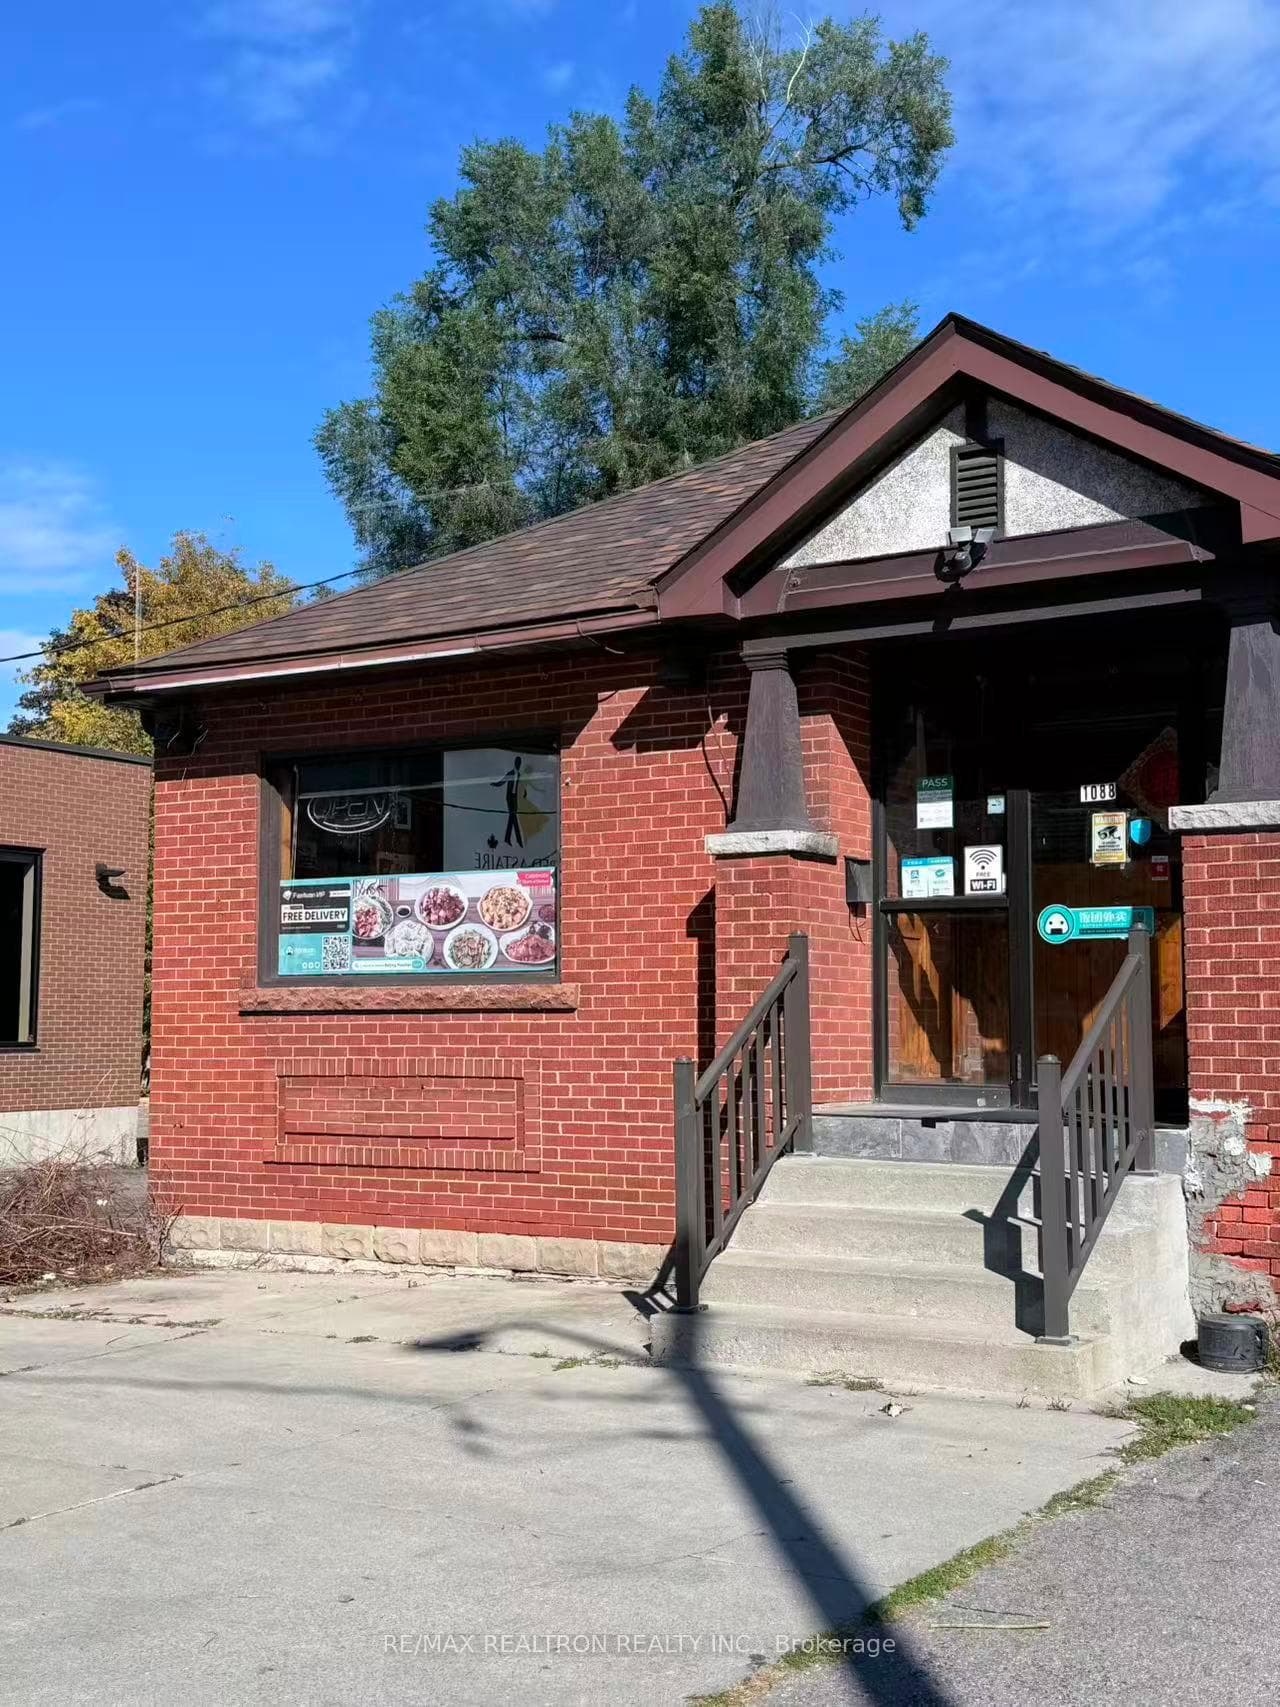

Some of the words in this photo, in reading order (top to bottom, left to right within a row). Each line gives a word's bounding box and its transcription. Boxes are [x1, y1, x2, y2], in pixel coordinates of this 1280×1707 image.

[922, 778, 948, 788] PASS
[1083, 783, 1115, 800] 1088
[971, 880, 996, 890] WI-FI
[282, 911, 303, 922] FREE
[304, 910, 346, 921] DELIVERY
